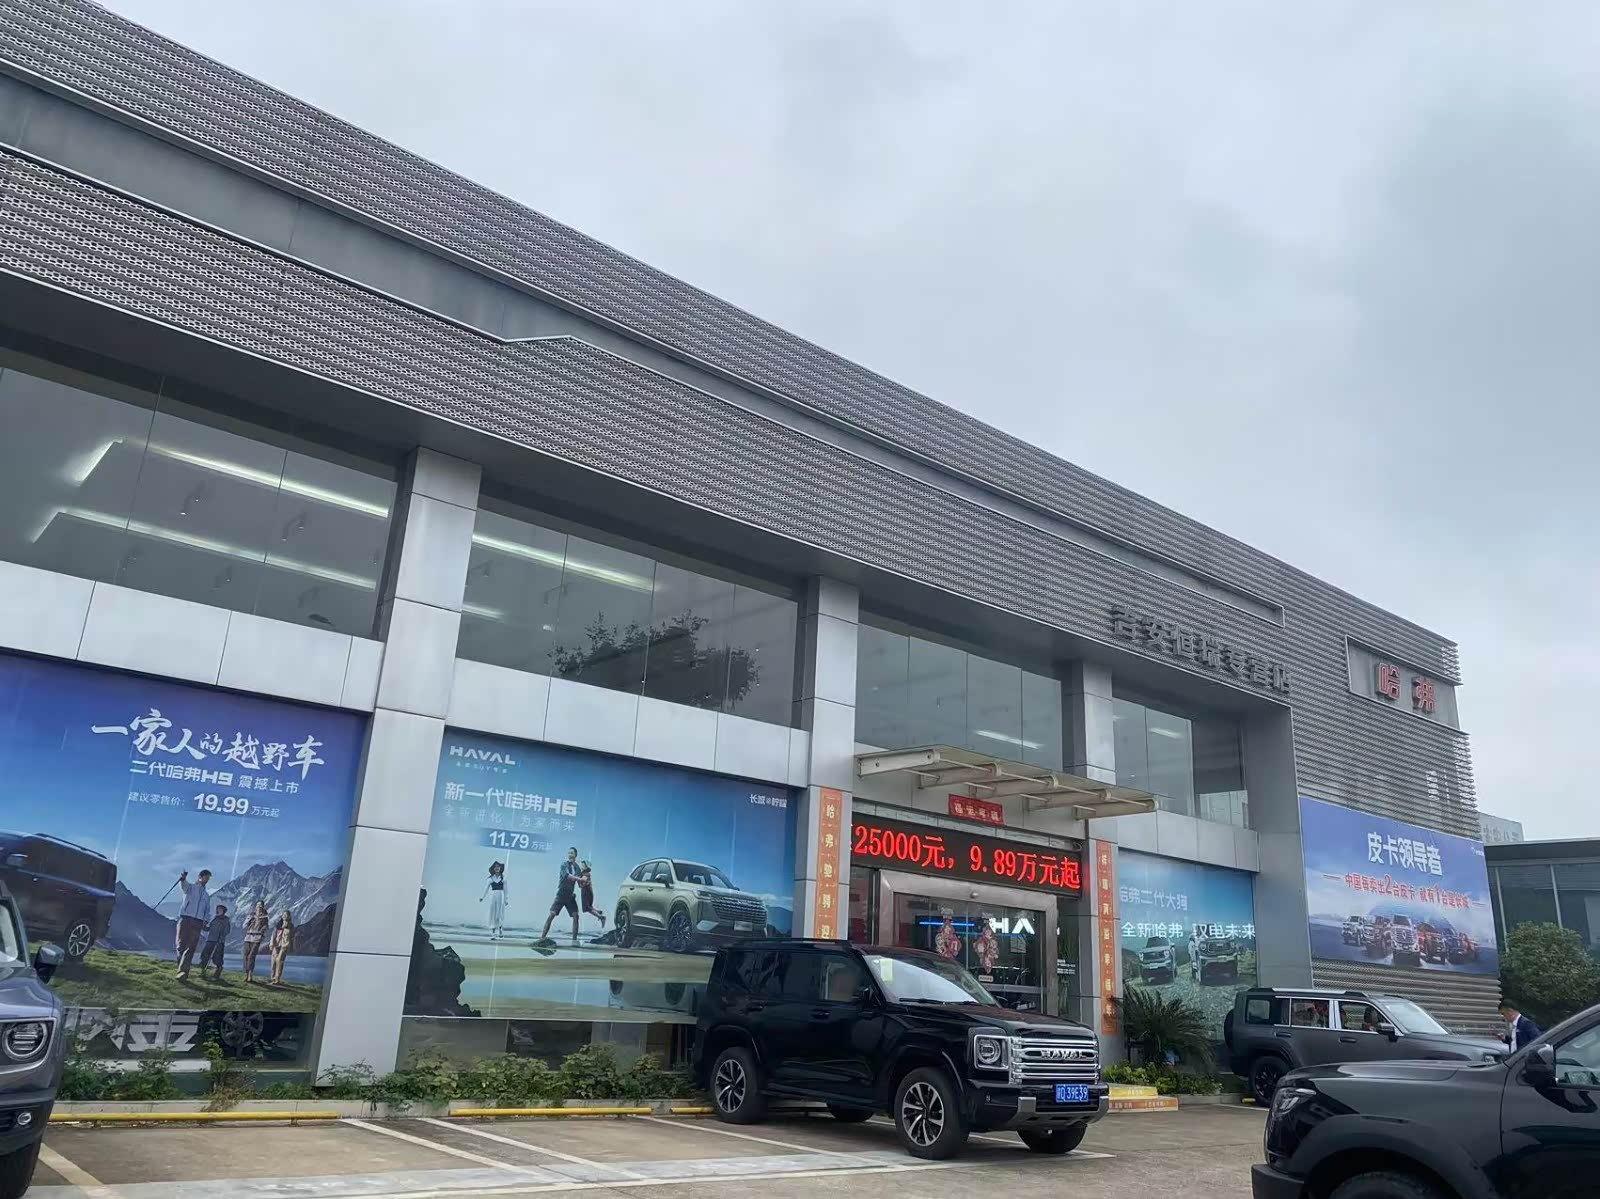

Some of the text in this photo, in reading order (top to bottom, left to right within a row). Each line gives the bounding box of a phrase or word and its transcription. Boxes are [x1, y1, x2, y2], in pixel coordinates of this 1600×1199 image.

[91, 708, 325, 780] 一家人的越野车
[449, 745, 516, 766] HAVAL
[129, 759, 300, 794] 二代哈弗H9 震撼上市
[444, 781, 578, 817] 新一代哈弗H6
[489, 830, 530, 849] 11.79
[1367, 831, 1443, 876] 皮卡领导者
[1121, 922, 1184, 939] 全新哈弗
